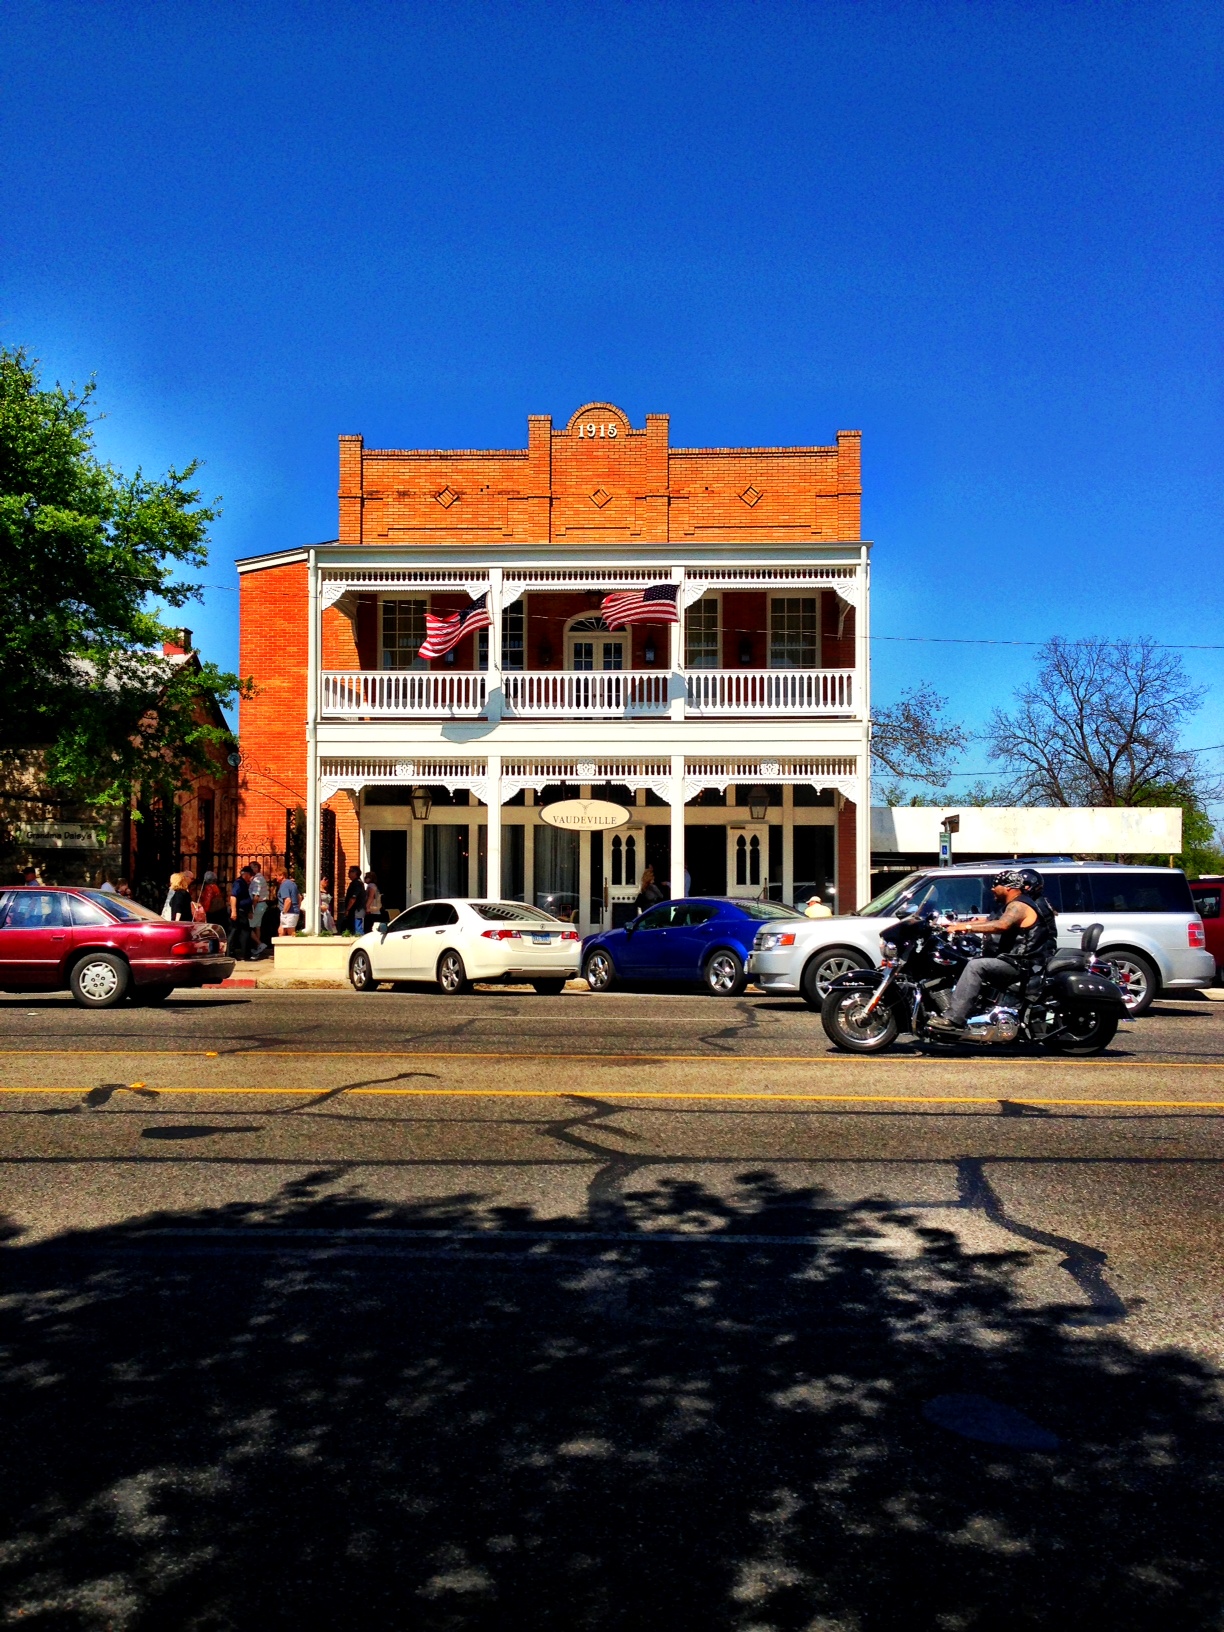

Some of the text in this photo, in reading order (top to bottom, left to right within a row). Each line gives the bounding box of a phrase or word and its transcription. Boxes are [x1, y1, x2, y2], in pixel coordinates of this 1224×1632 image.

[578, 423, 617, 438] 1915
[553, 815, 617, 825] VAUDEVILLE
[64, 832, 92, 841] Daisy's
